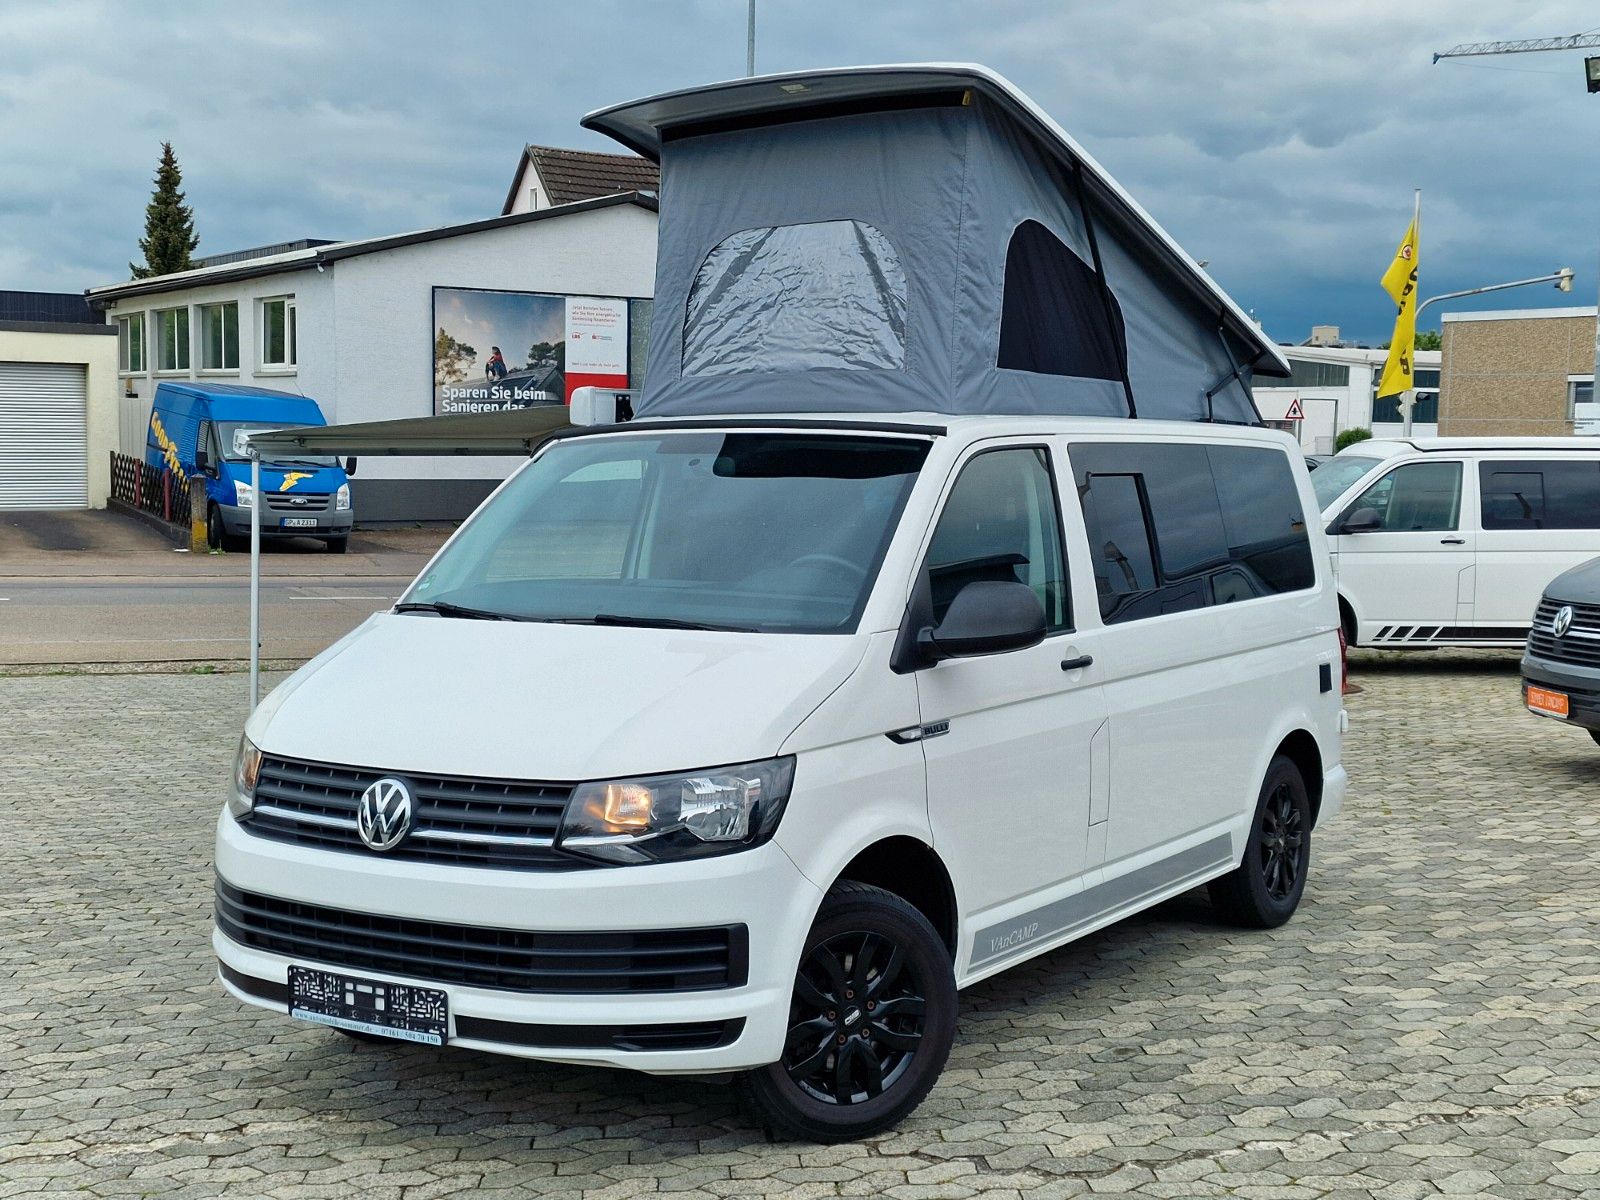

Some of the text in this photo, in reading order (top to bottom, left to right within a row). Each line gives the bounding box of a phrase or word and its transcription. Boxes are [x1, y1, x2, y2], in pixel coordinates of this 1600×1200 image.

[442, 385, 546, 400] Sparen Sie beim
[442, 400, 499, 413] Sanieren
